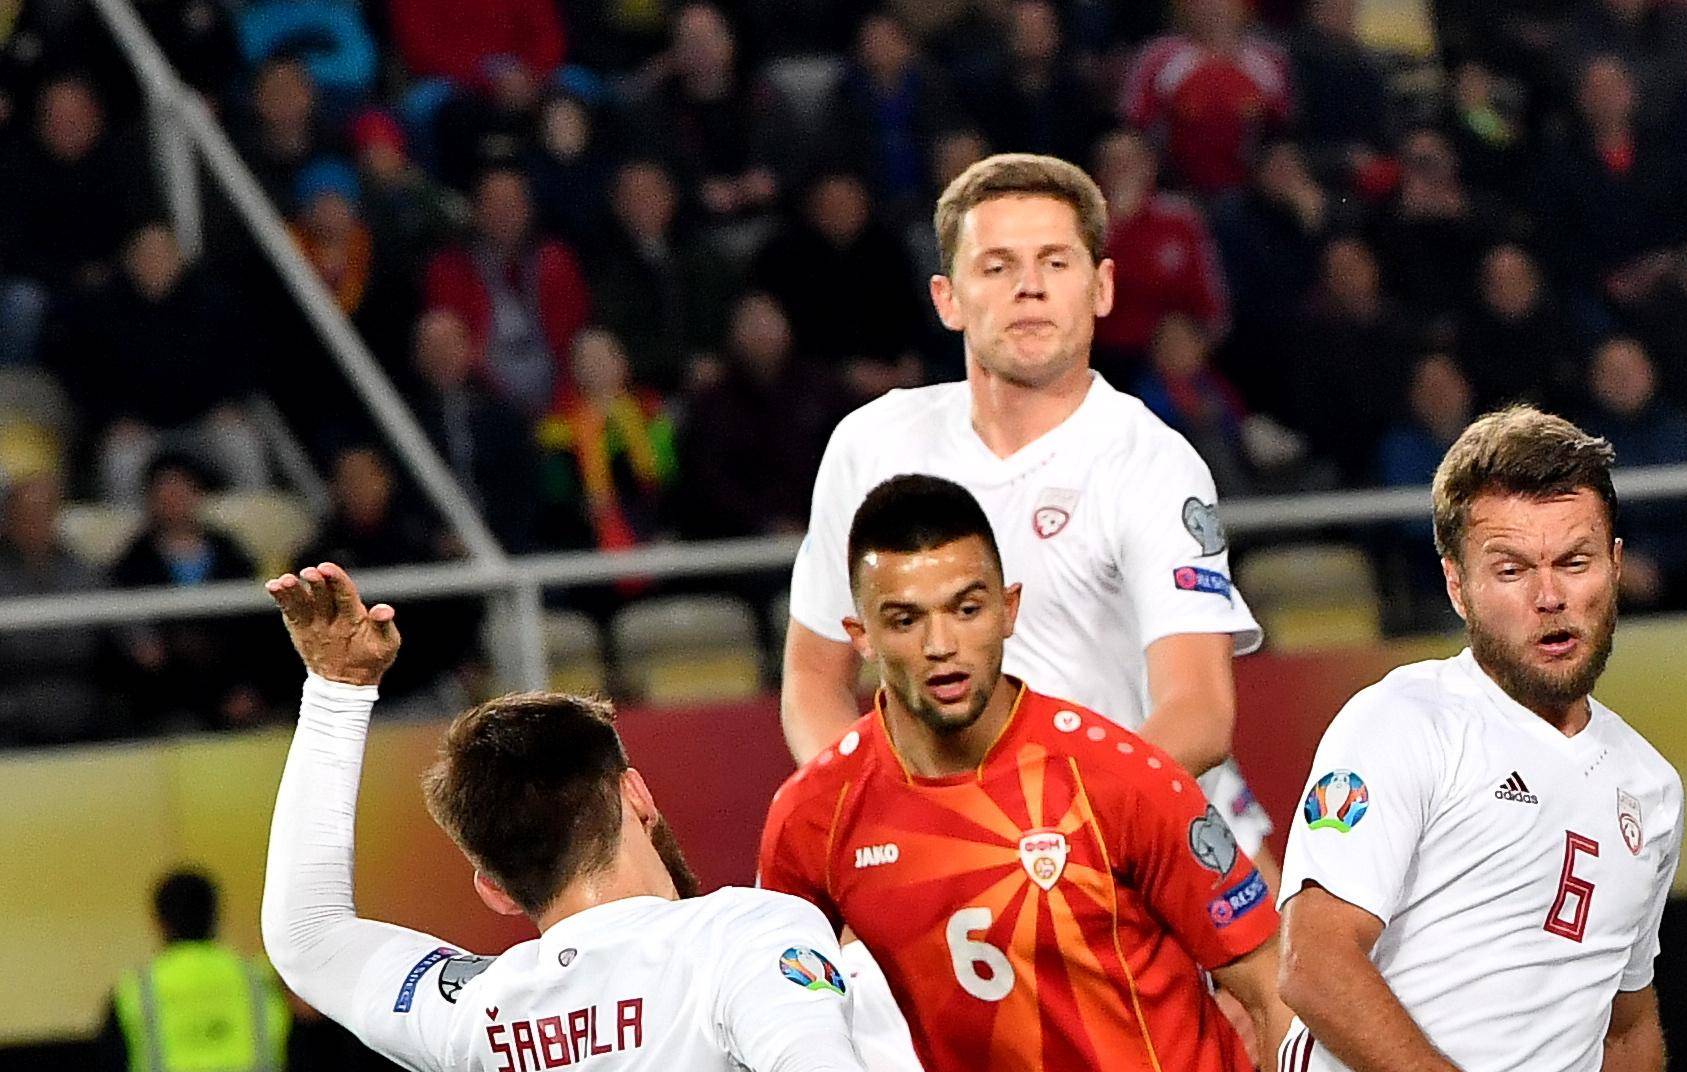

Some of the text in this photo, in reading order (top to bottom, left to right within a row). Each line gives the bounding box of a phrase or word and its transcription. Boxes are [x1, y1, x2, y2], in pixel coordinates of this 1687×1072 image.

[1494, 789, 1539, 805] adidas
[854, 842, 900, 869] JAKO
[1543, 829, 1600, 943] 6
[945, 907, 1016, 1002] 6
